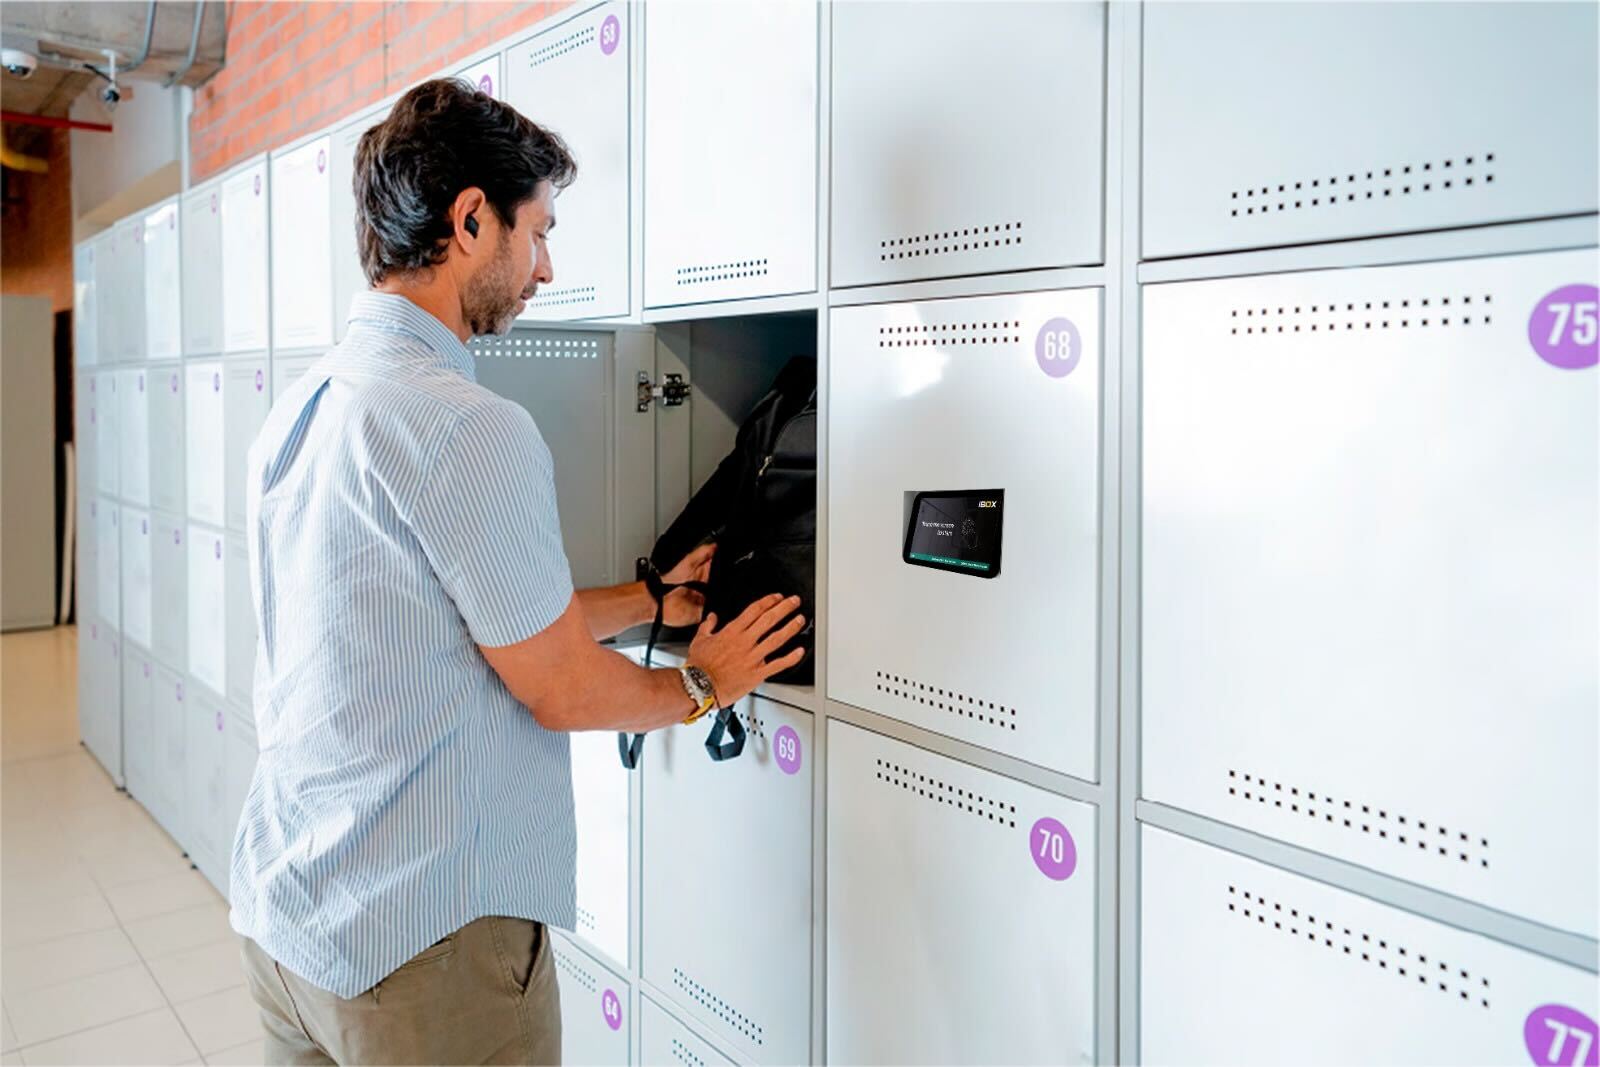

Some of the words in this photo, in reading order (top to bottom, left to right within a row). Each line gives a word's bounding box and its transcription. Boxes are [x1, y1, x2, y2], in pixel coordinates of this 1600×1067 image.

[1546, 301, 1597, 347] 75
[1044, 331, 1070, 360] 68
[778, 735, 795, 762] 69
[1039, 828, 1063, 863] 70
[605, 995, 617, 1020] 64
[1544, 1018, 1593, 1067] 77
